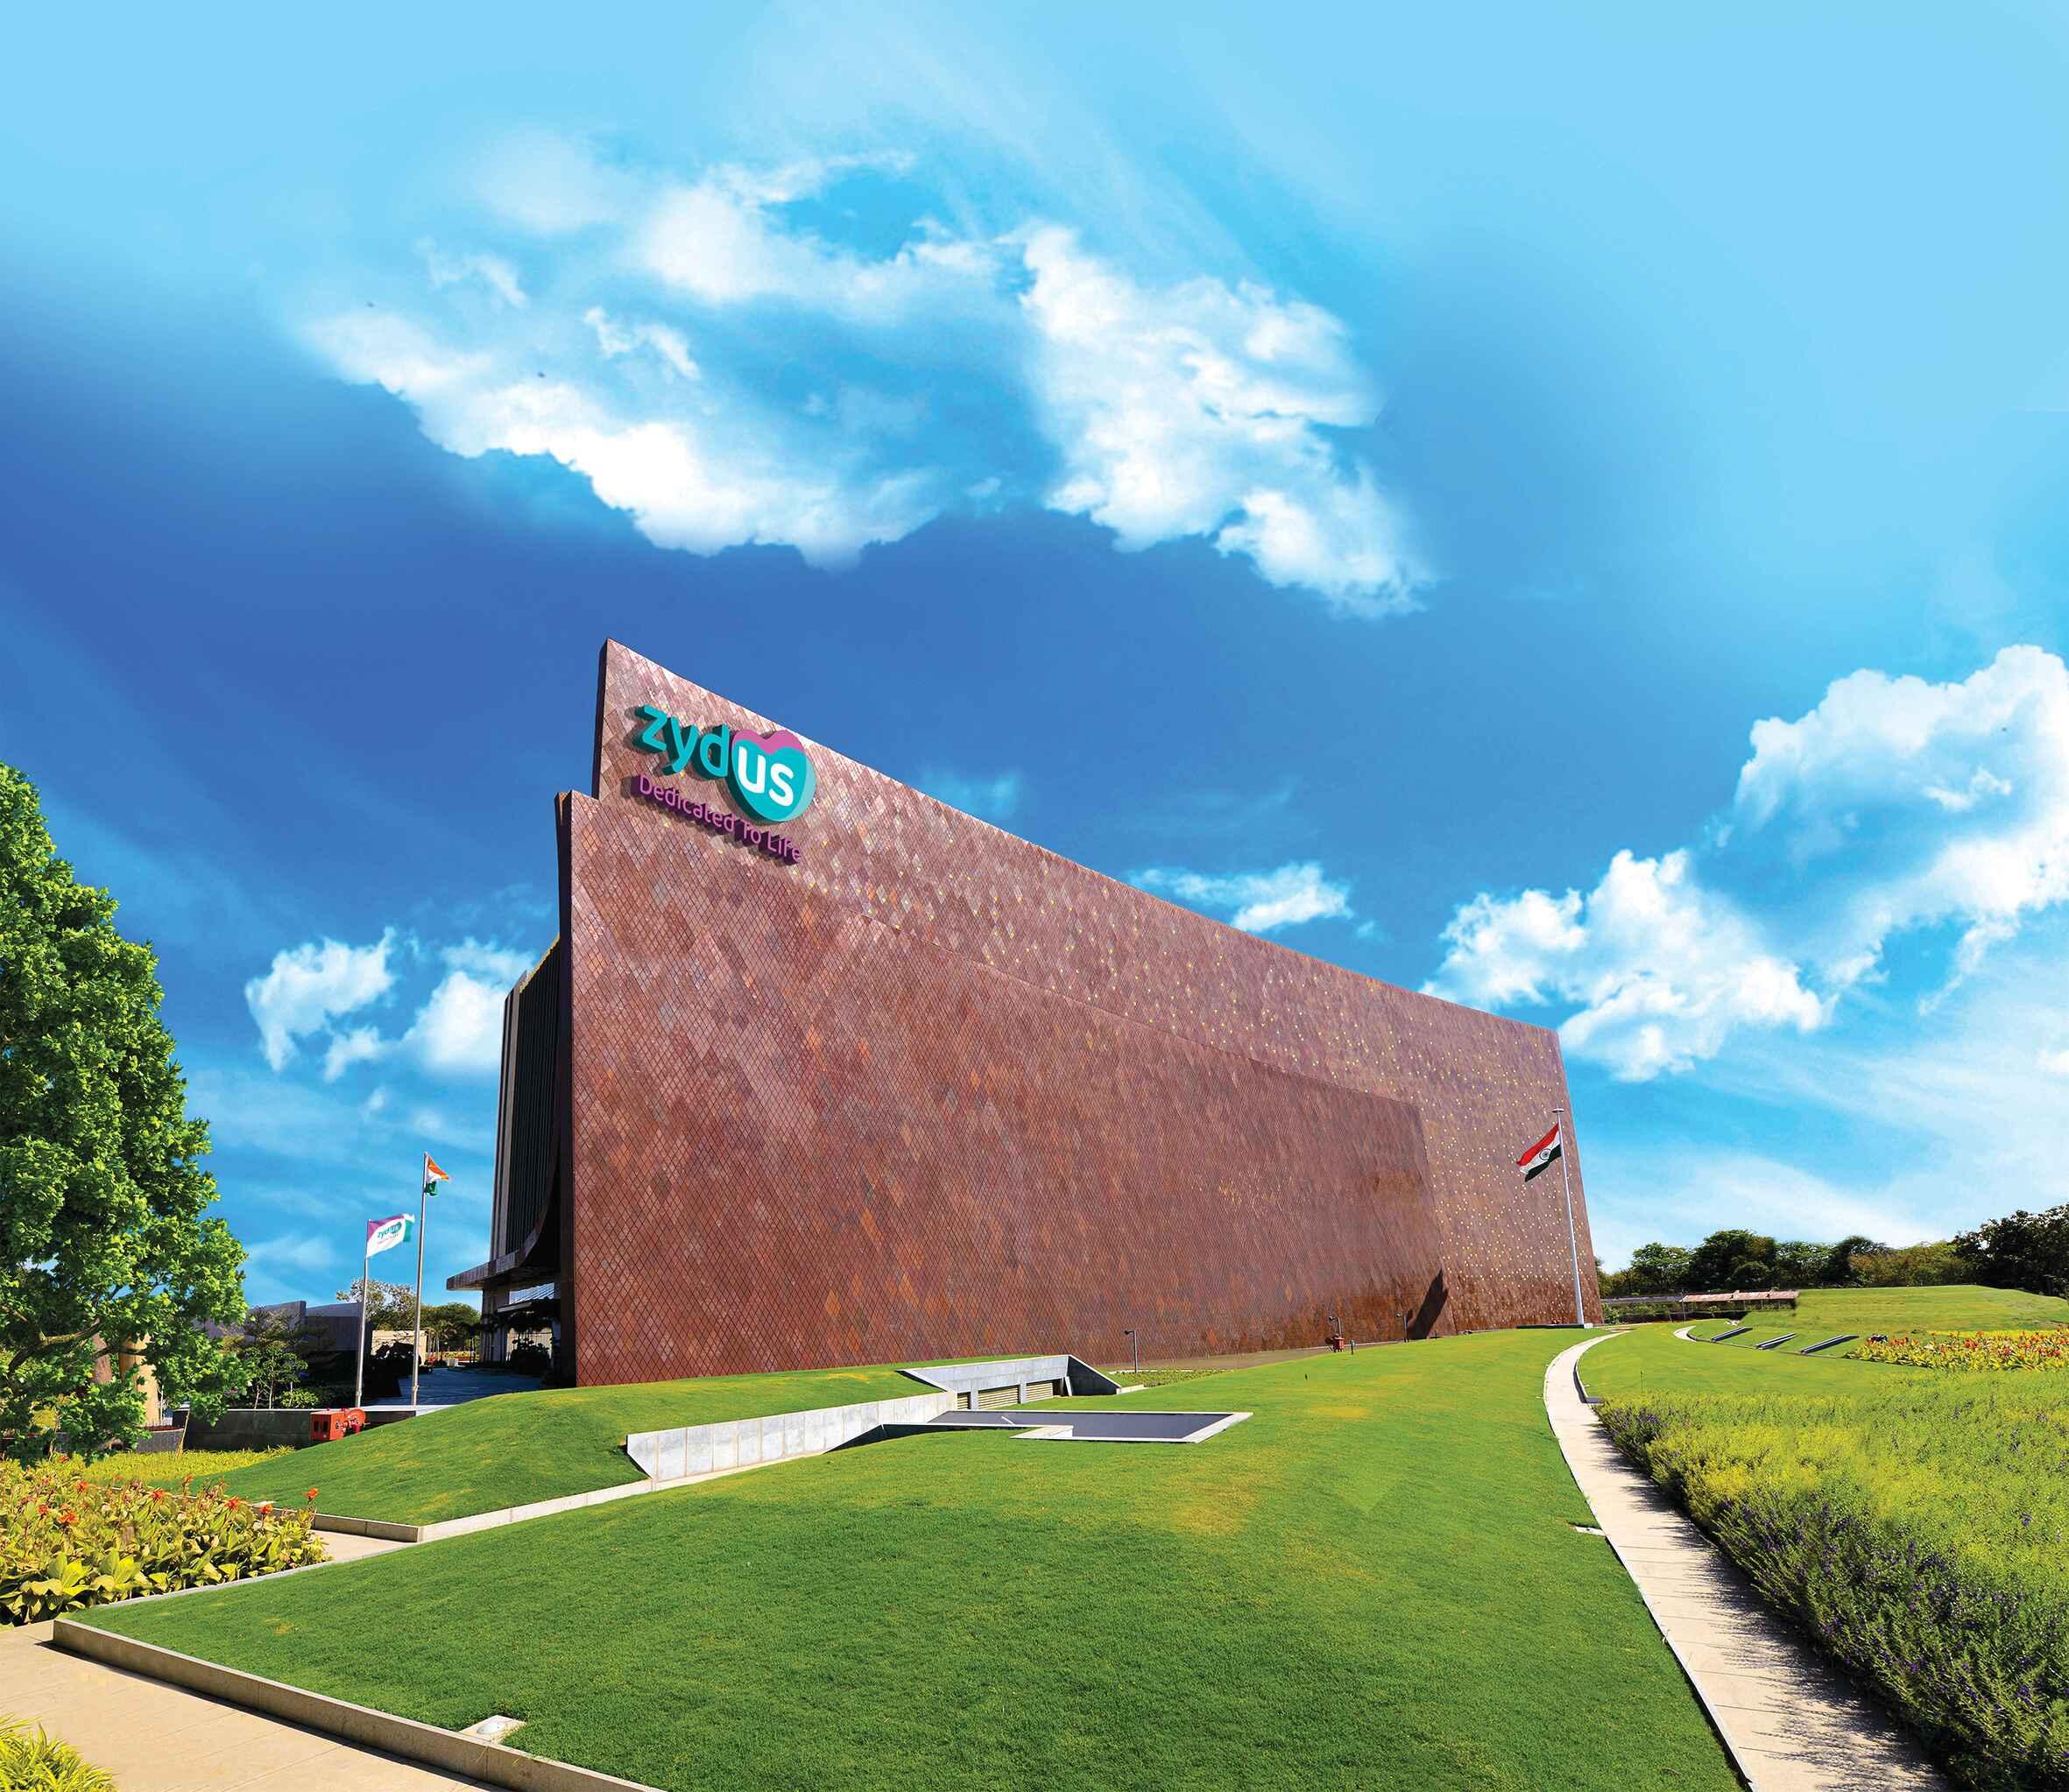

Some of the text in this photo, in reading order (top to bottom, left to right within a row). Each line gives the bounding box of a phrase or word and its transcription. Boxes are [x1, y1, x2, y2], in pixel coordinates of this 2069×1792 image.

[640, 703, 795, 808] zydus
[639, 774, 802, 863] Dedicated To Life
